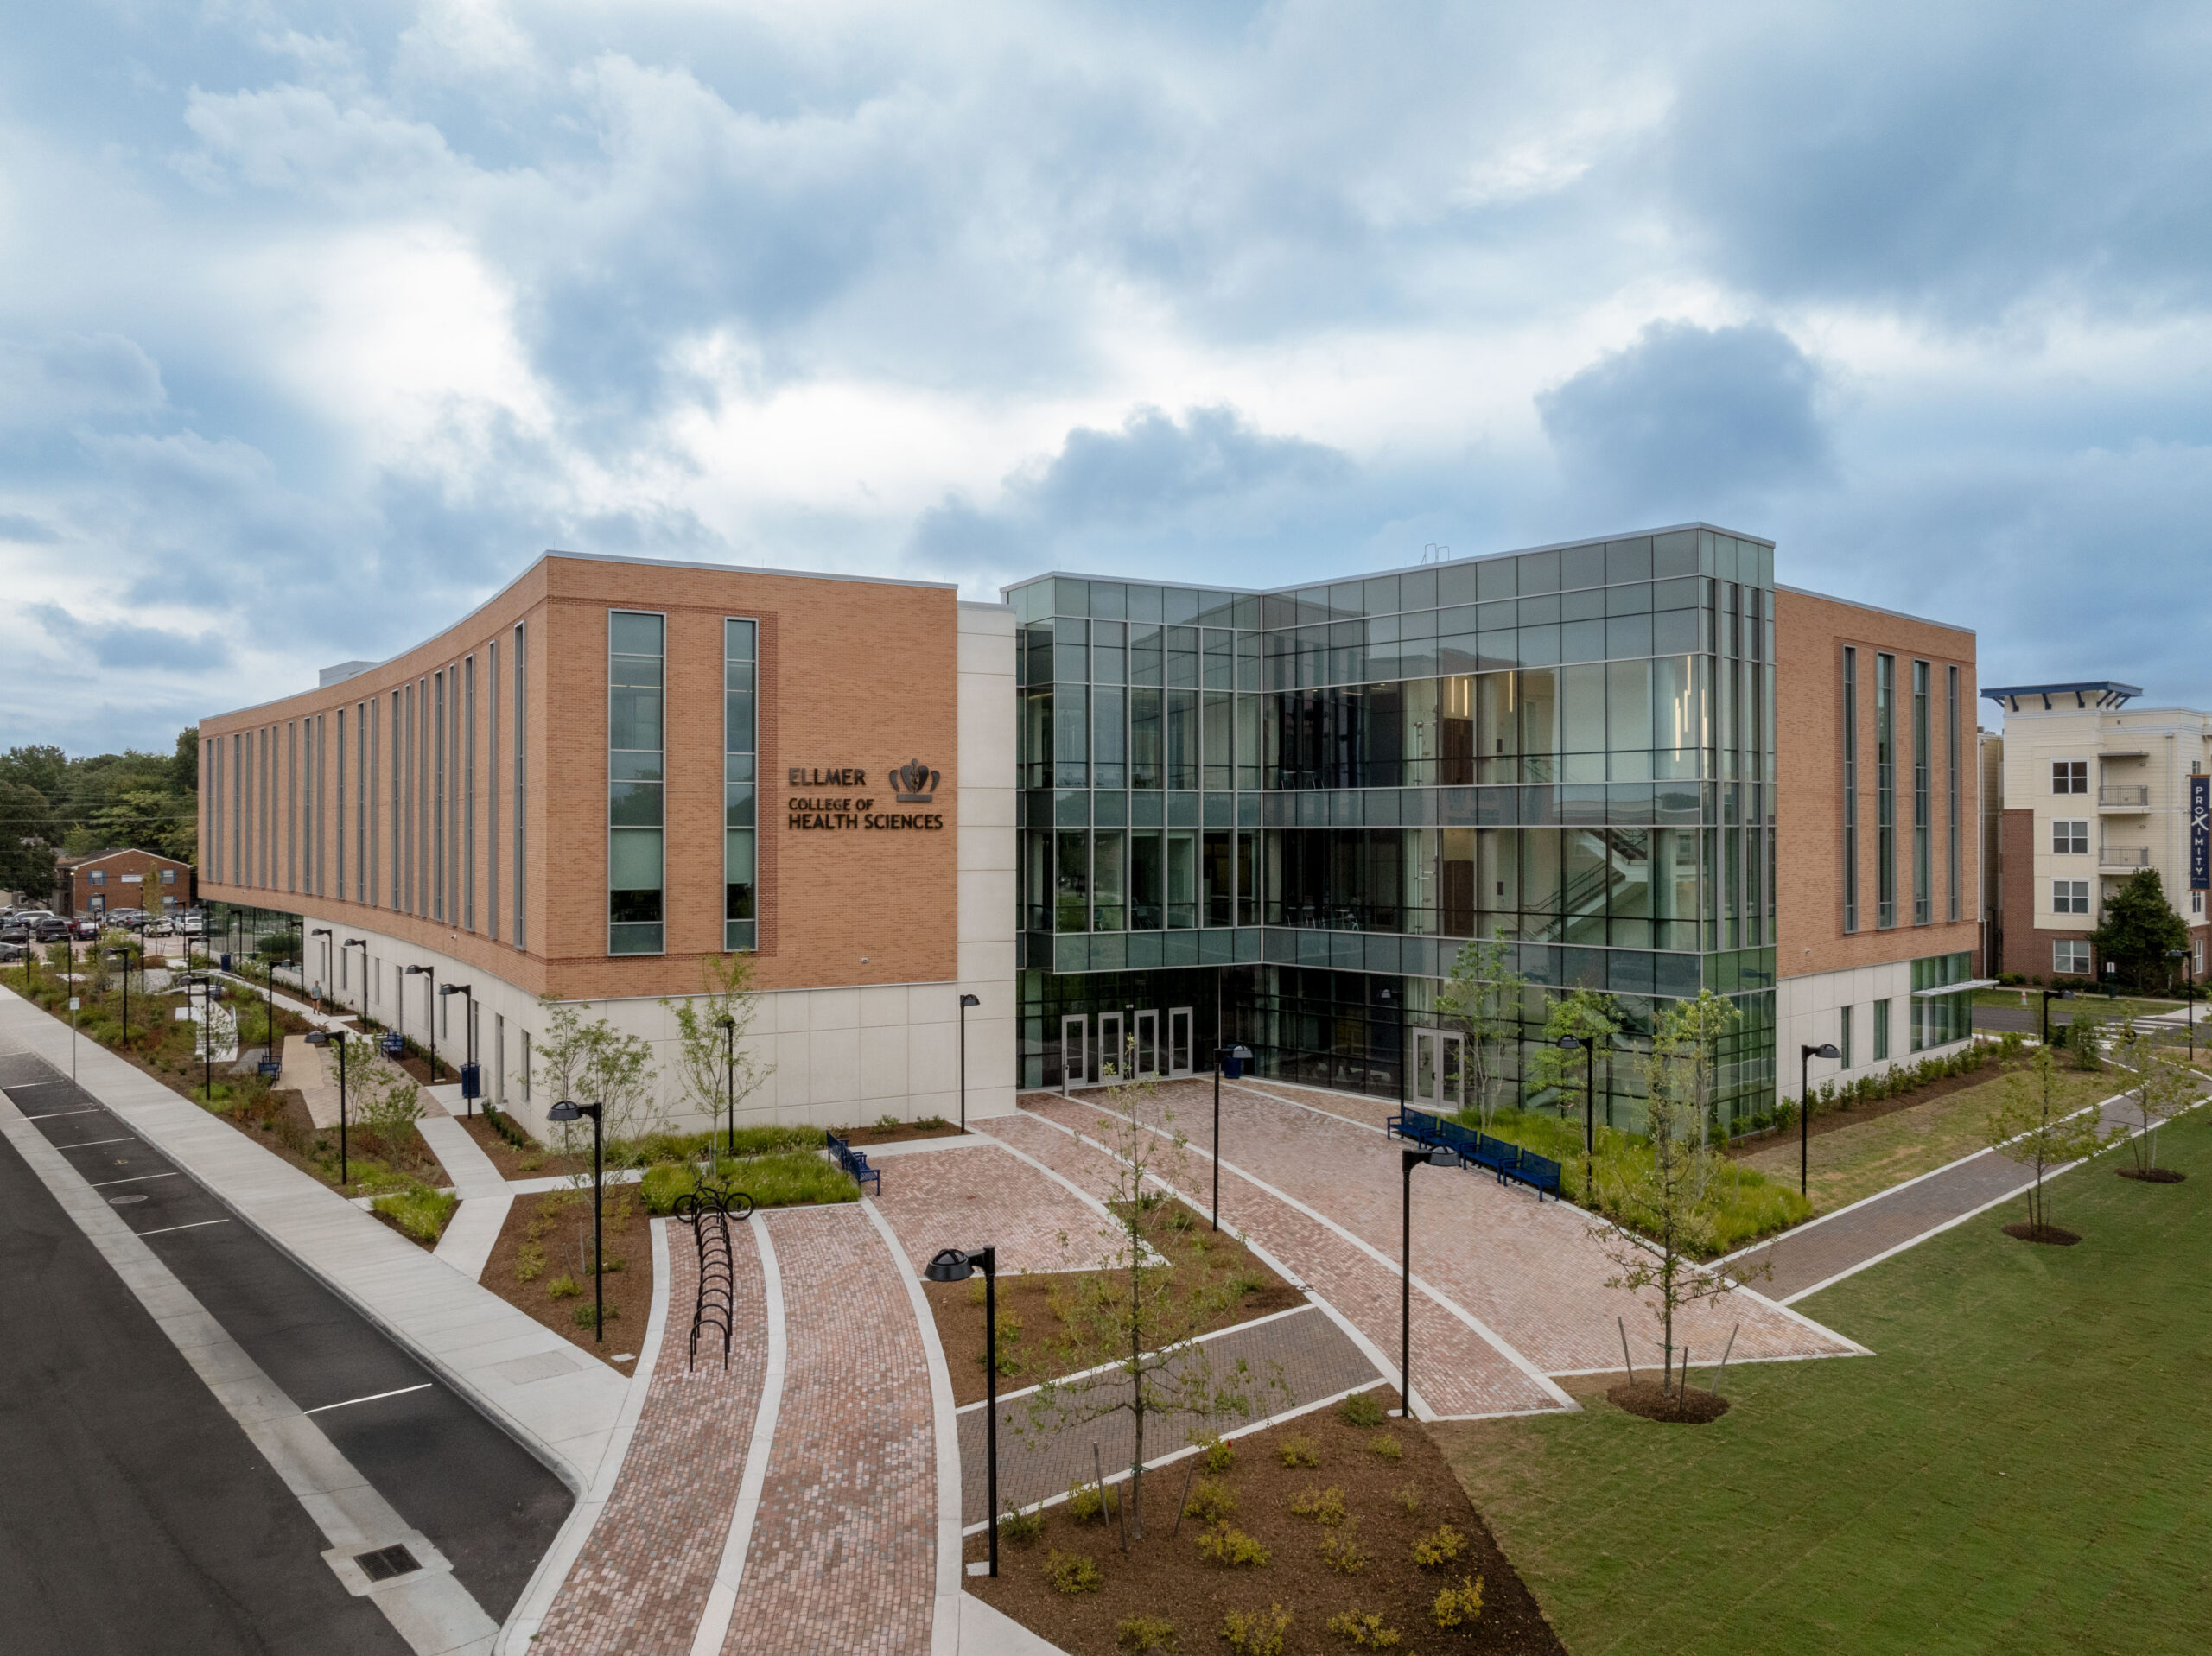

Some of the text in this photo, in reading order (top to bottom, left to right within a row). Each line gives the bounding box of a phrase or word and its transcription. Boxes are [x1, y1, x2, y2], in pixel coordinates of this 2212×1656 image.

[789, 767, 867, 785] ELLMER
[789, 798, 874, 810] COLLEGE OF
[789, 814, 943, 829] HEALTH SCIENCES
[2191, 786, 2209, 875] PROXIMITY
